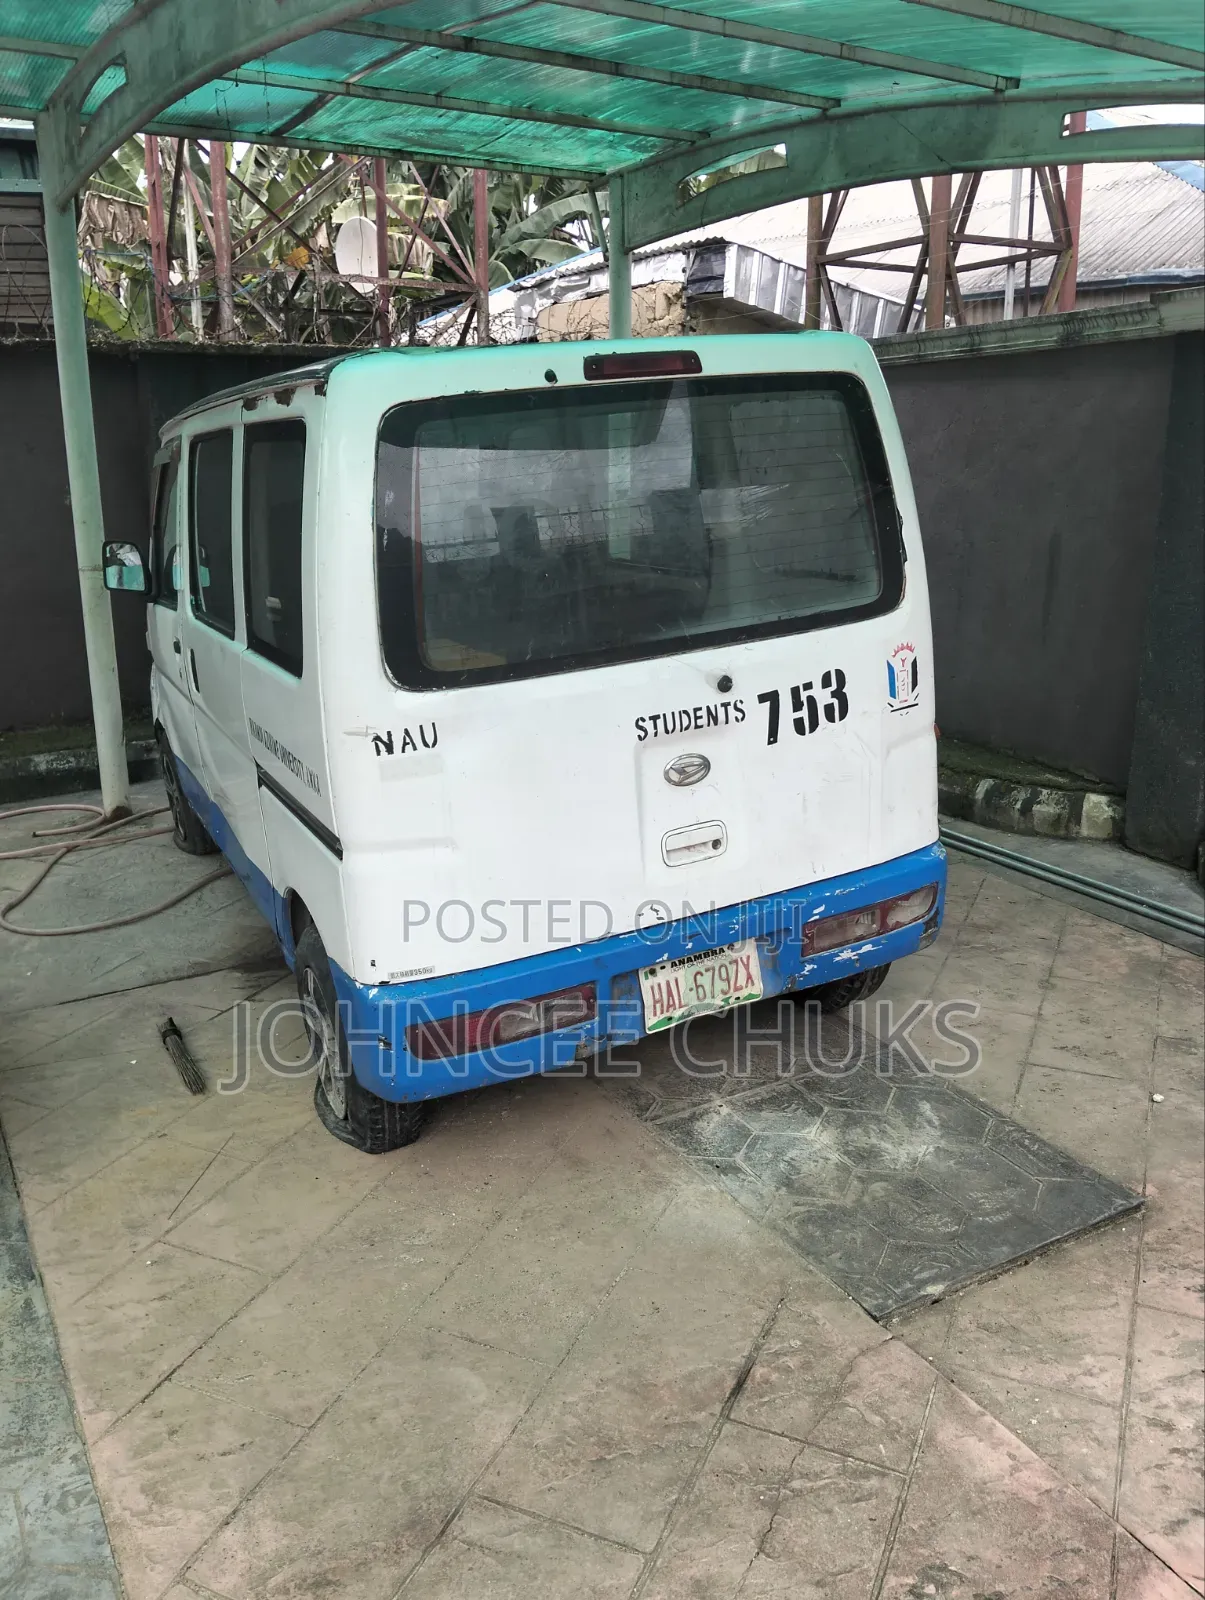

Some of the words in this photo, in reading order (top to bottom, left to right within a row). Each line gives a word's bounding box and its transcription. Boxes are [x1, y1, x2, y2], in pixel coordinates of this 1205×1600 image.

[634, 699, 746, 741] STUDENTS
[757, 668, 849, 745] 753
[371, 722, 438, 756] NAU
[671, 947, 726, 968] ANAMBRA
